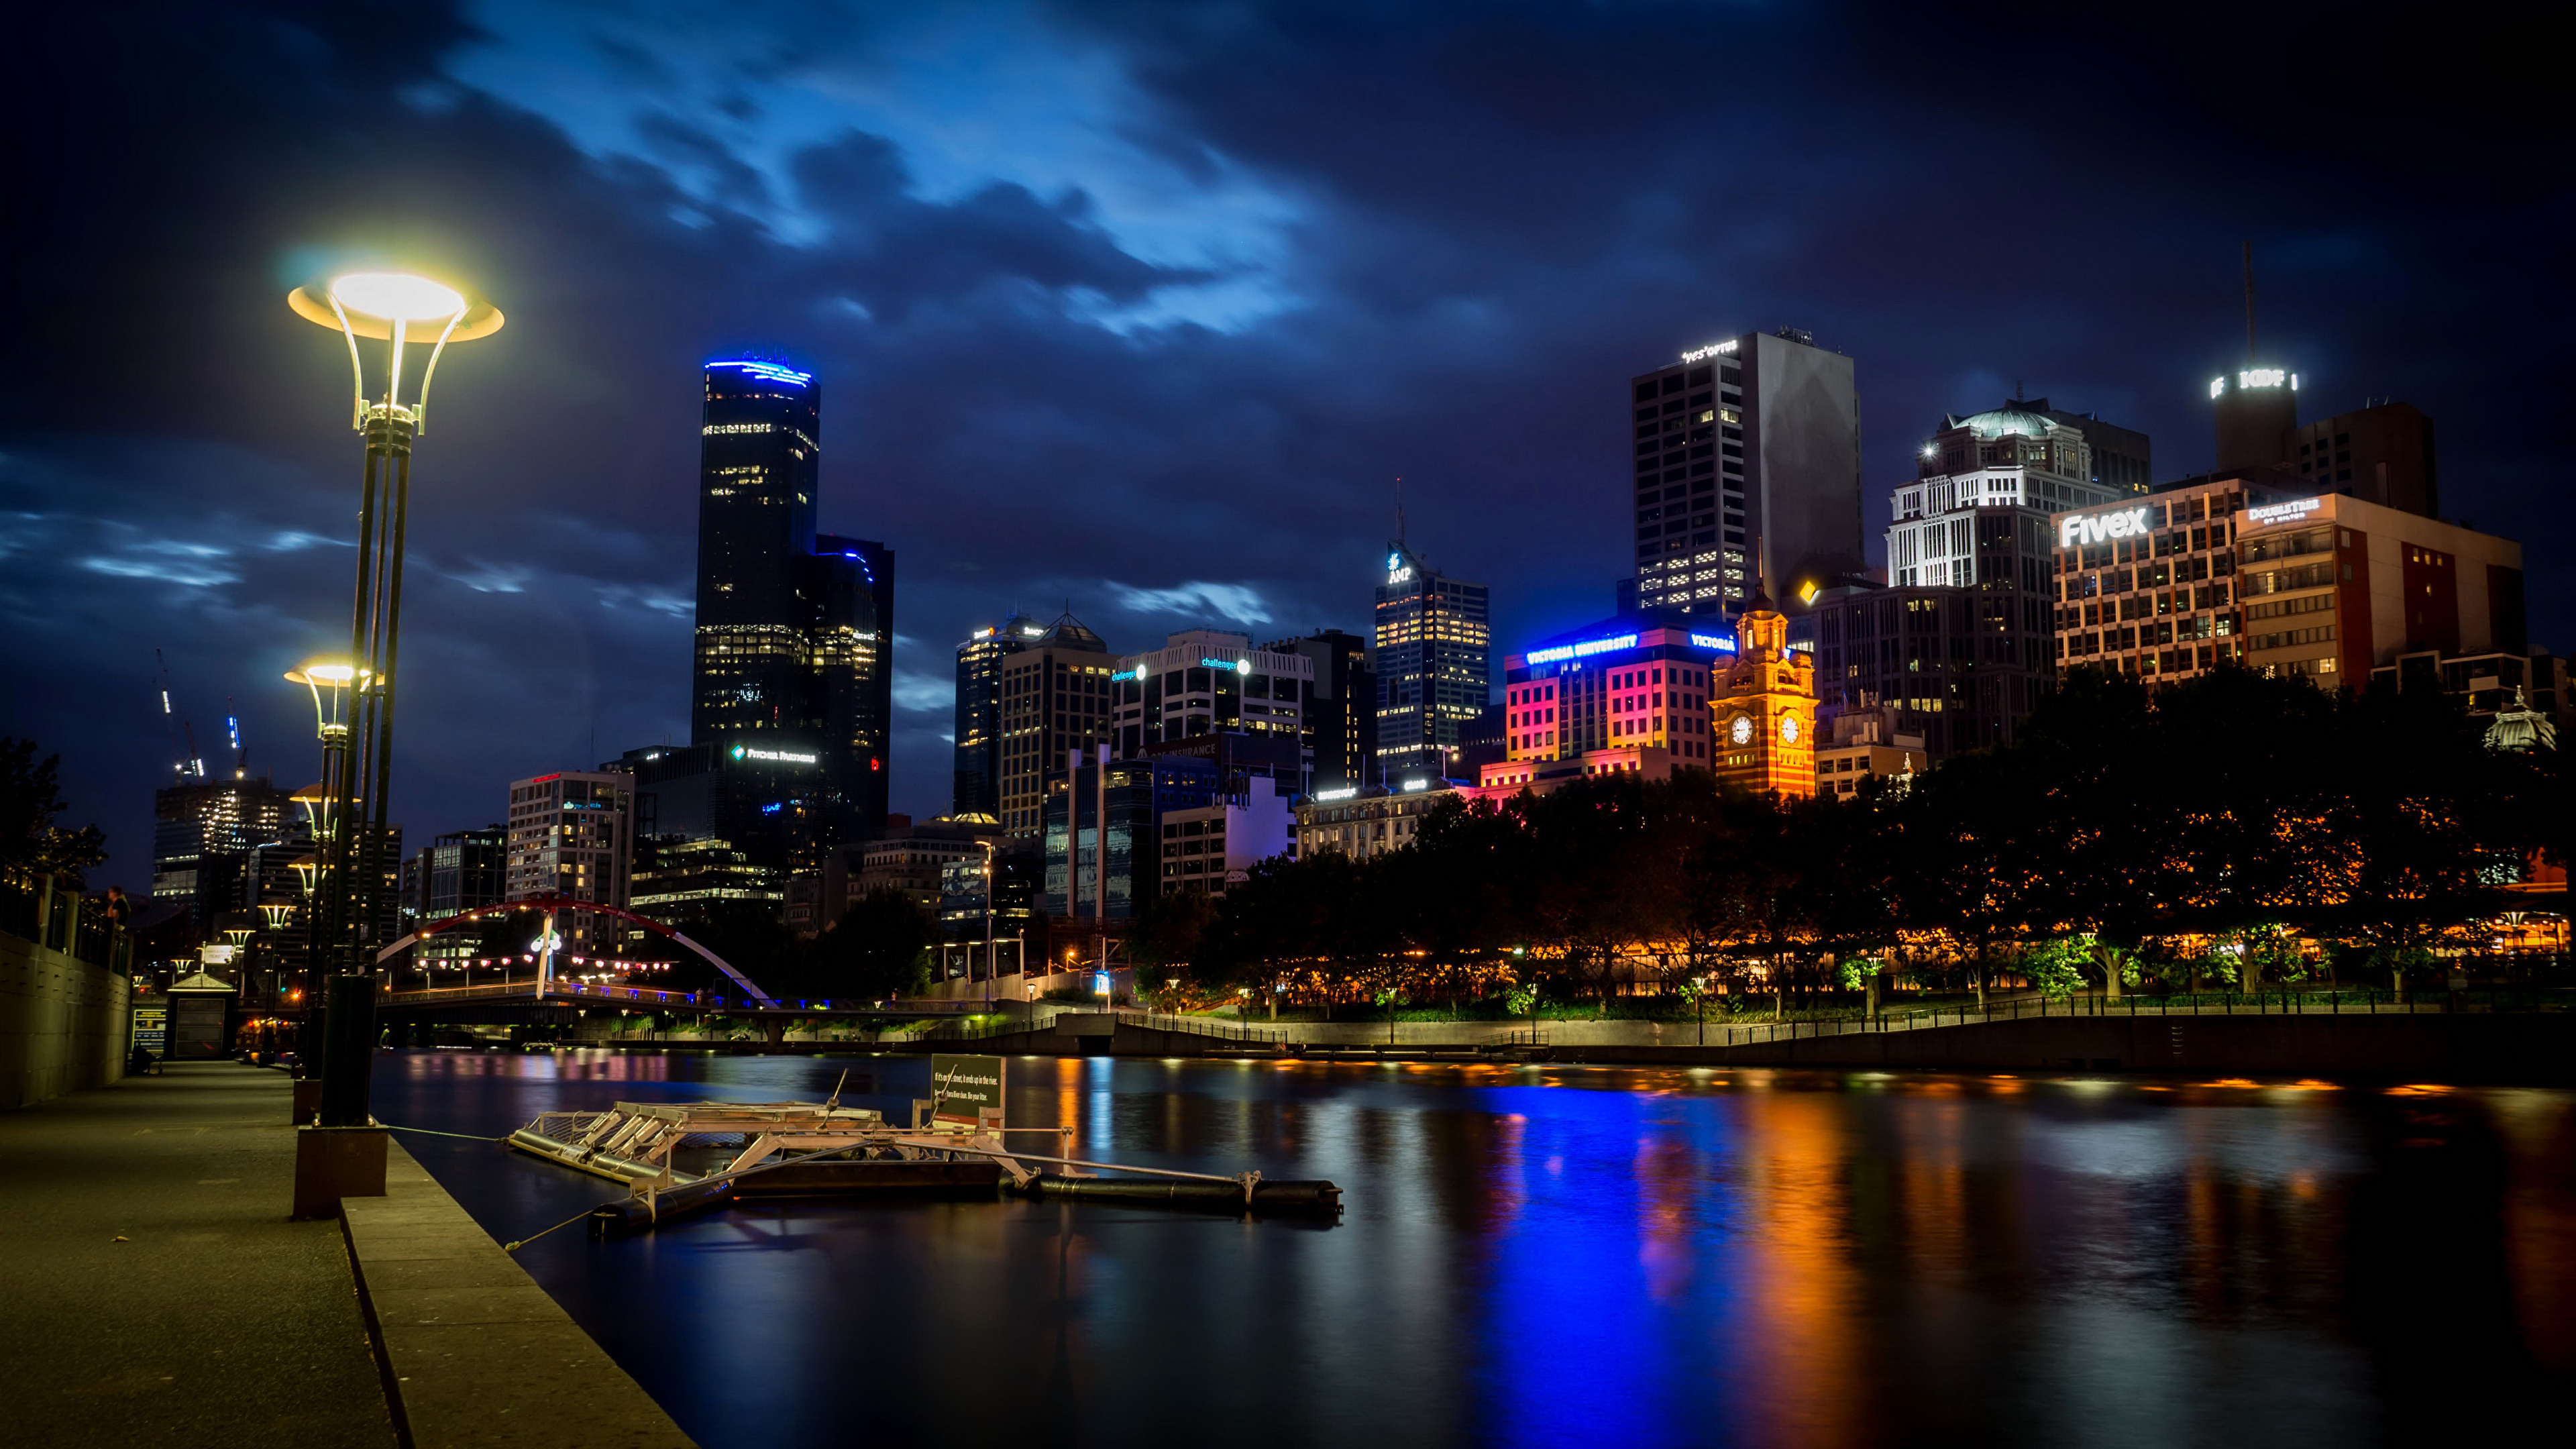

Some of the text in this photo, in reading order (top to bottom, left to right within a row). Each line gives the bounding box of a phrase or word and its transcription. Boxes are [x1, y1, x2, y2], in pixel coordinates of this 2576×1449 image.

[2062, 508, 2147, 547] Fivex
[1389, 568, 1411, 584] AMP
[1527, 635, 1637, 665] VICTORIA UNIVERSITY
[1691, 634, 1735, 651] VICTORIA
[1202, 657, 1237, 670] challenger
[1112, 671, 1136, 682] challenger
